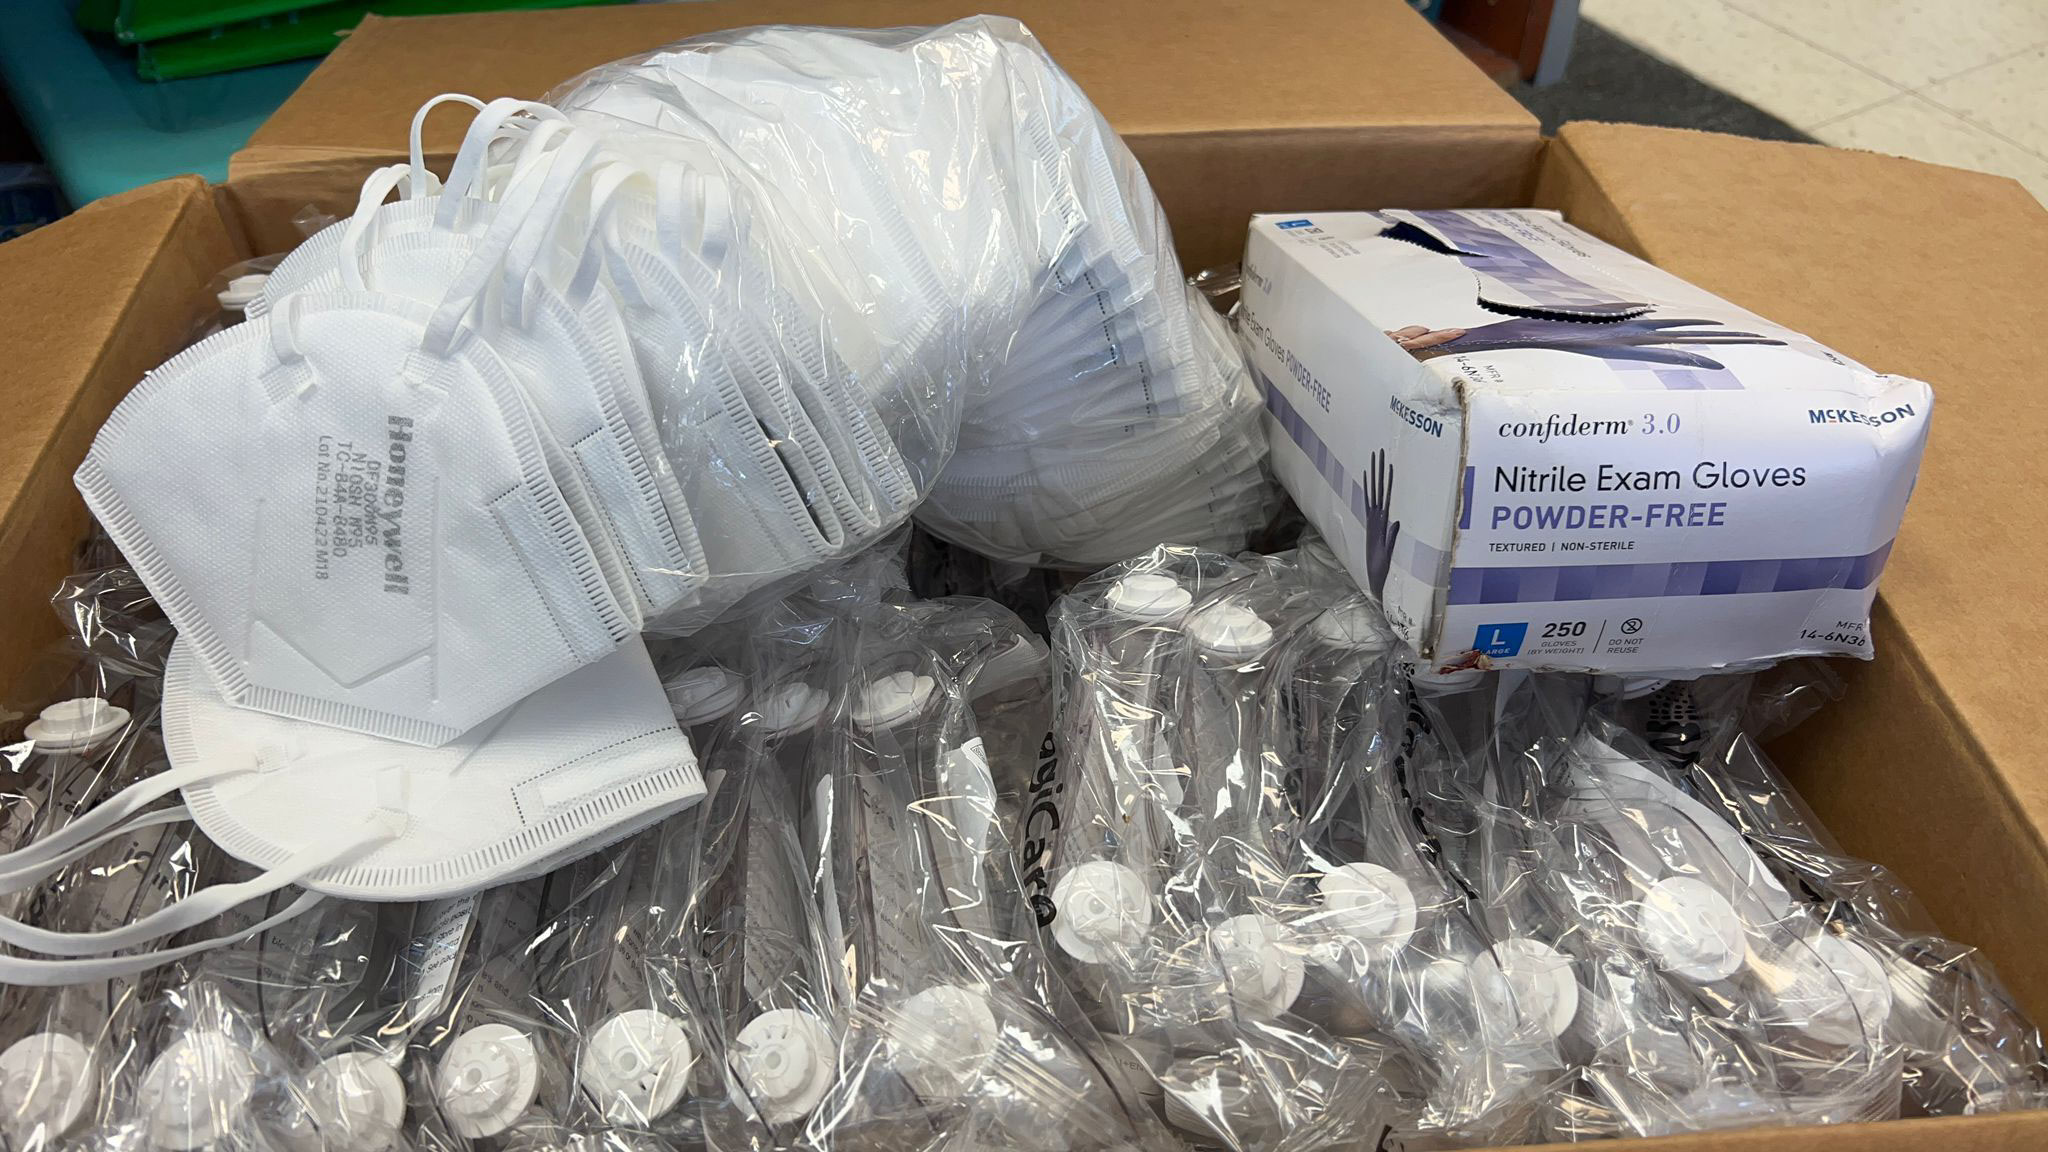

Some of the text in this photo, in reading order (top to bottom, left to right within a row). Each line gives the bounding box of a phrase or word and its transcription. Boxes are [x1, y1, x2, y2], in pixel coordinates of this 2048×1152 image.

[1264, 327, 1285, 363] Gloves
[1285, 349, 1332, 414] POWDER-FREE
[1641, 412, 1681, 435] 3.0
[319, 435, 333, 458] Lot
[349, 452, 368, 507] NIOSH
[1494, 461, 1807, 493] Nitrile Exam Gloves
[377, 415, 414, 595] Honeywell
[1490, 502, 1728, 531] POWDER-FREE
[1489, 541, 1635, 553] TEXTURED NON-STERILE
[1491, 628, 1506, 646] L
[1541, 621, 1587, 639] 250
[1836, 621, 1864, 632] MFR
[1541, 640, 1577, 648] GLOVES
[1607, 646, 1640, 654] REUSE
[1024, 731, 1064, 928] agiCare
